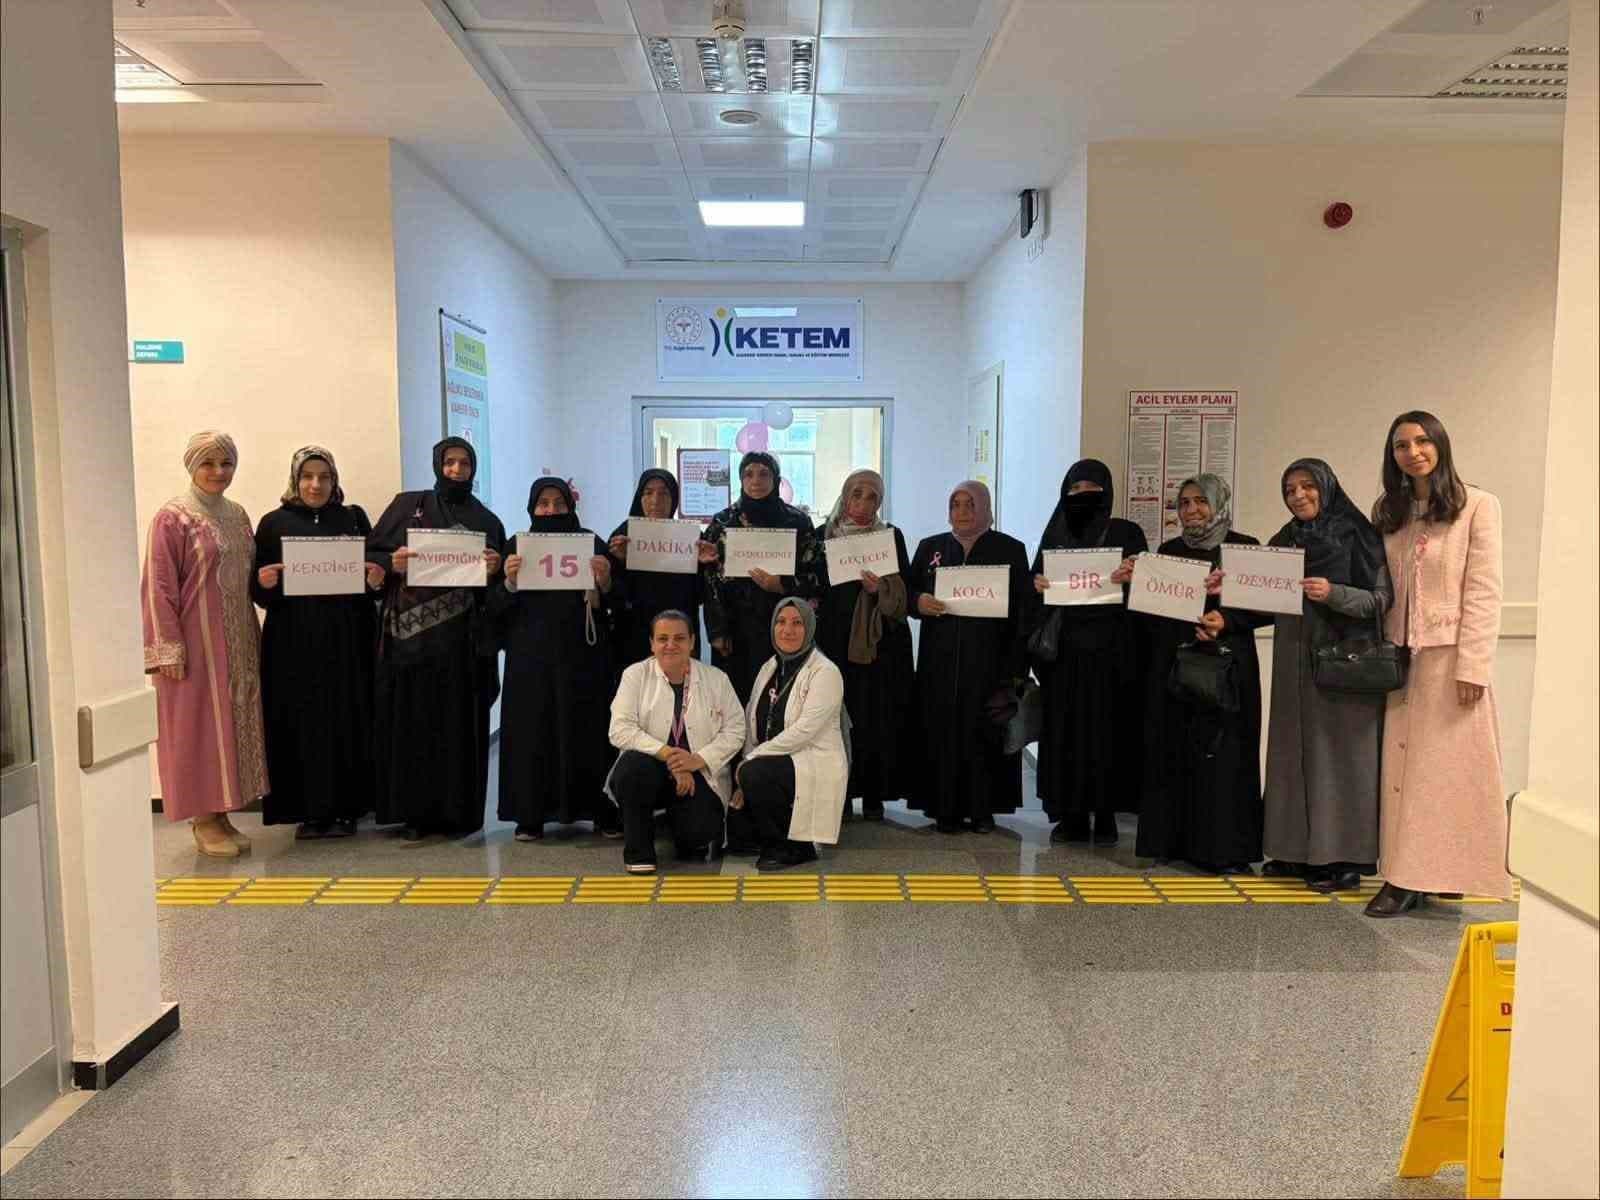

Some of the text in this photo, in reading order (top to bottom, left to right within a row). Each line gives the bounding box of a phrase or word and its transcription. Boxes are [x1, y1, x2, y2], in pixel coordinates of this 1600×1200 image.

[736, 327, 850, 349] KETEM
[1135, 393, 1232, 405] ACİL EYLEM PLANI
[636, 539, 693, 555] DAKİKA
[292, 560, 360, 574] KENDİNE
[539, 554, 578, 578] 15
[1069, 570, 1102, 590] BİR
[1146, 576, 1195, 600] ÖMÜR
[1237, 573, 1297, 593] DEMEK
[952, 585, 995, 599] KOCA
